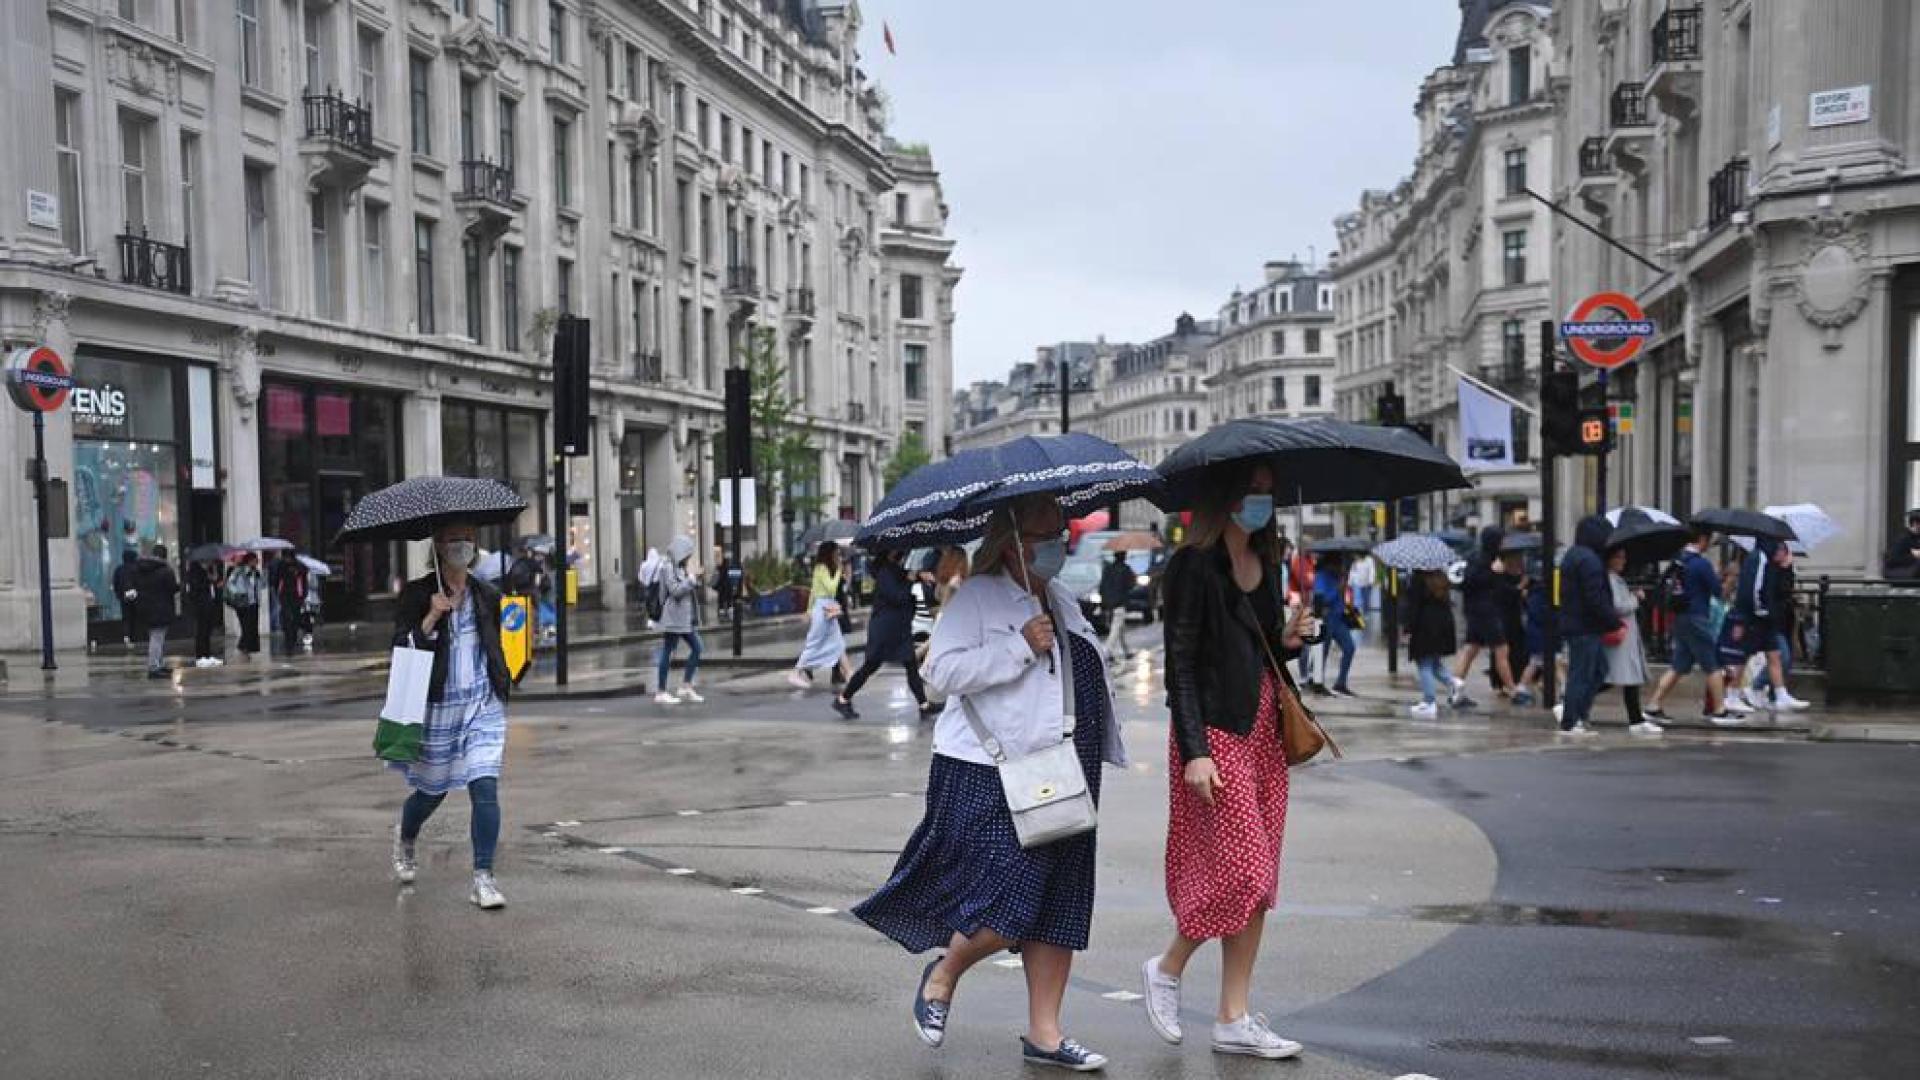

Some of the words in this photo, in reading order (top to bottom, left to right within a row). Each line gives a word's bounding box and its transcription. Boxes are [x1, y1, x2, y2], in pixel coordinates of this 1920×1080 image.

[1814, 92, 1850, 105] OXFORD
[1814, 102, 1847, 115] CIRCUS
[1562, 323, 1651, 336] UNDERGROUND
[22, 371, 71, 387] UNDERGROUND
